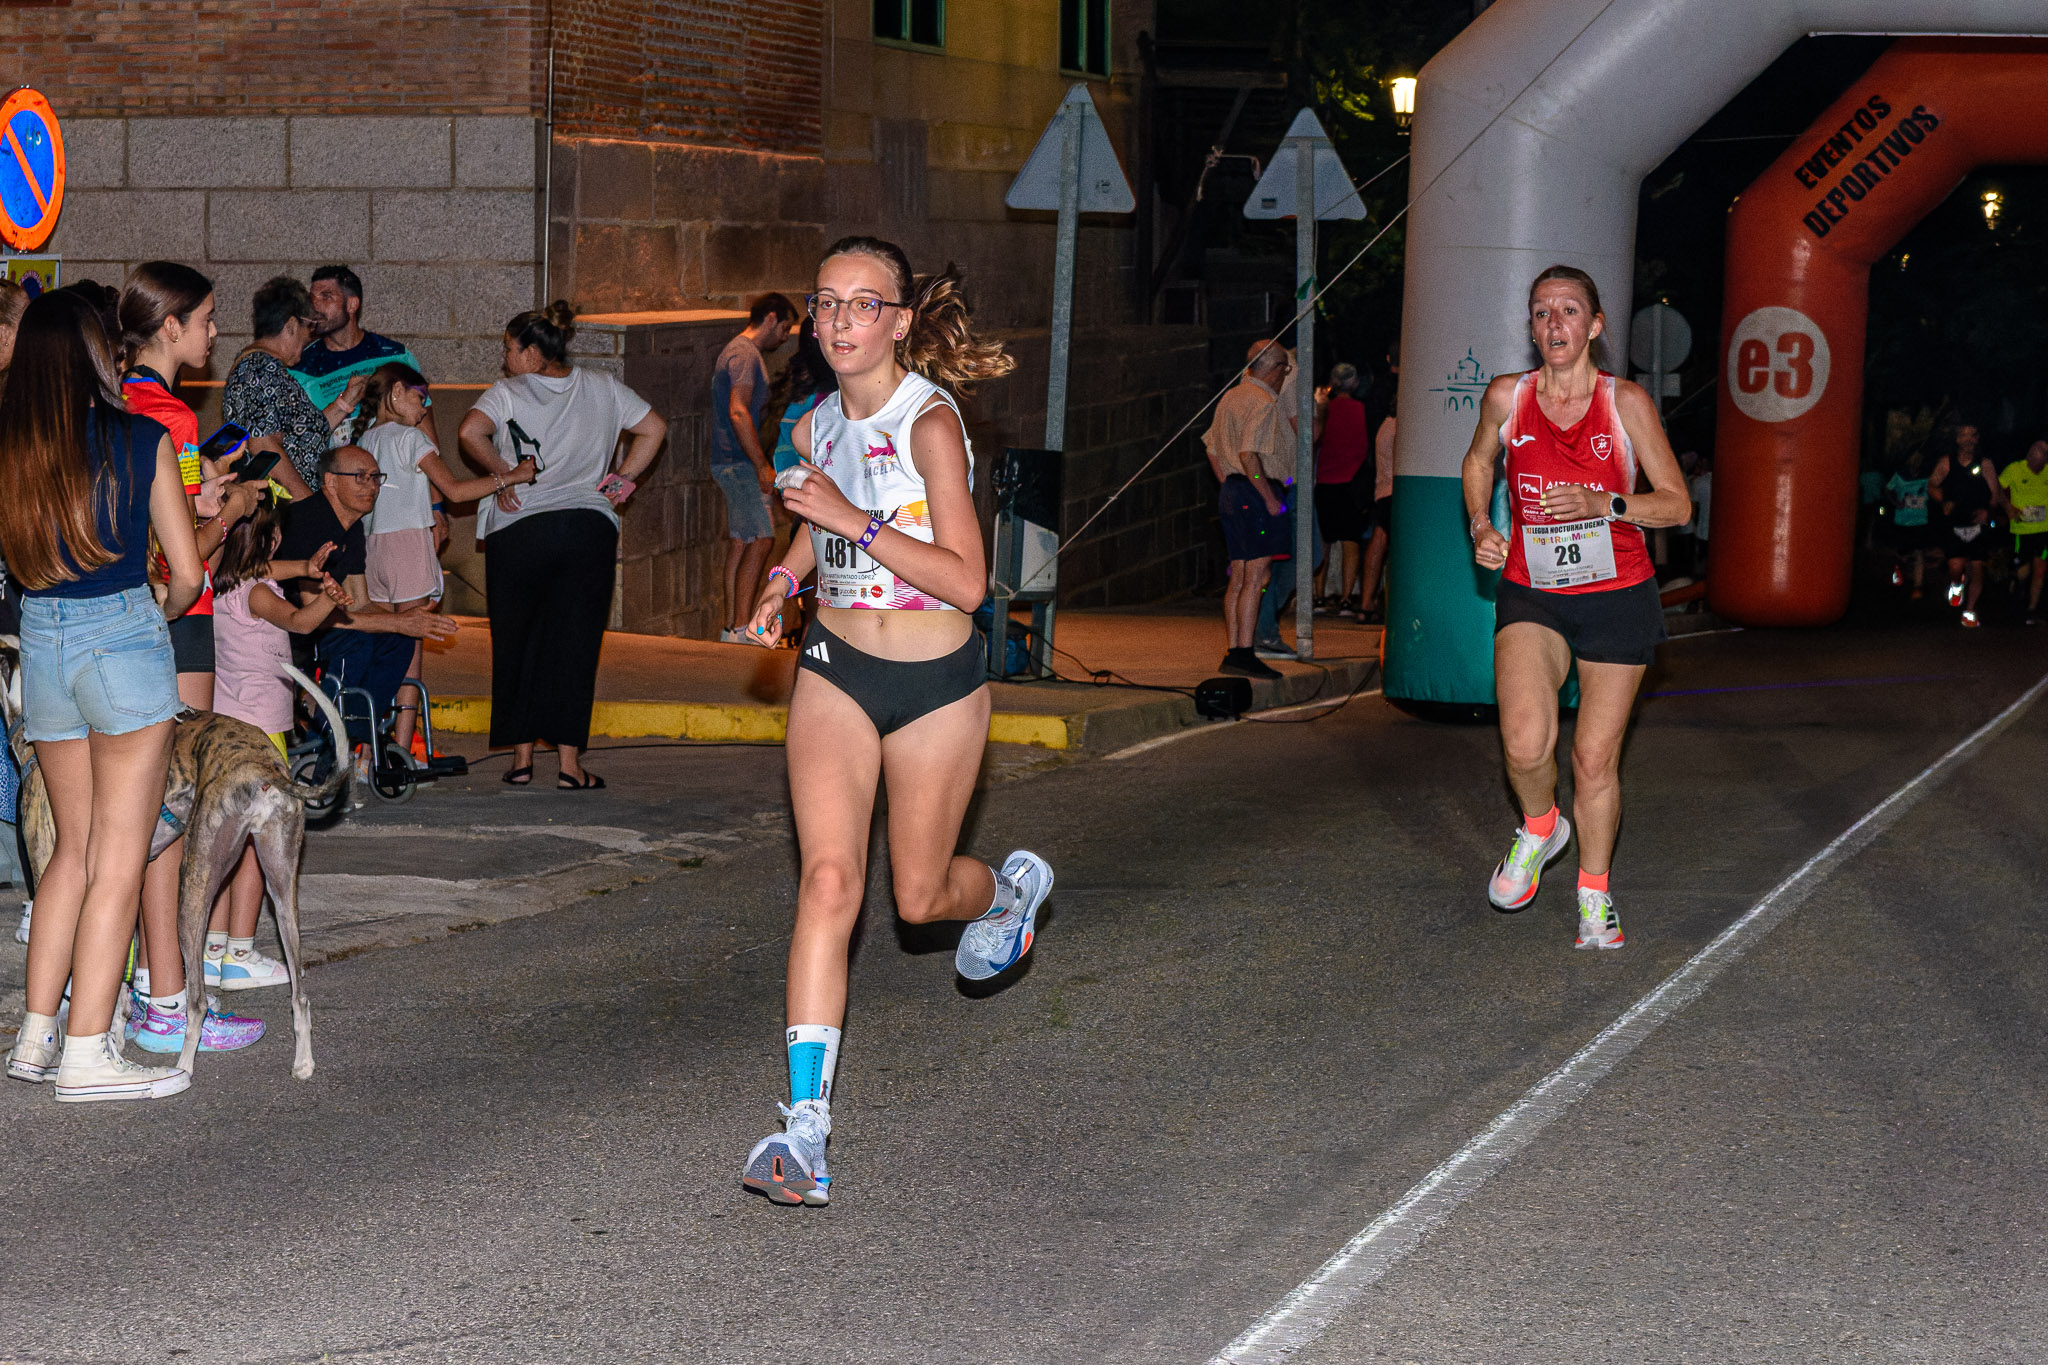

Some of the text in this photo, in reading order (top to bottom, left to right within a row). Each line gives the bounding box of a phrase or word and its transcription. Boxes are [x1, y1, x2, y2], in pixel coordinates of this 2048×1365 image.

[1795, 95, 1892, 189] EVENTOS
[1803, 105, 1940, 238] DEPORTIVOS
[1738, 332, 1814, 399] e3
[1550, 523, 1584, 534] NOCTURNA
[824, 538, 857, 569] 481
[1554, 543, 1582, 567] 28
